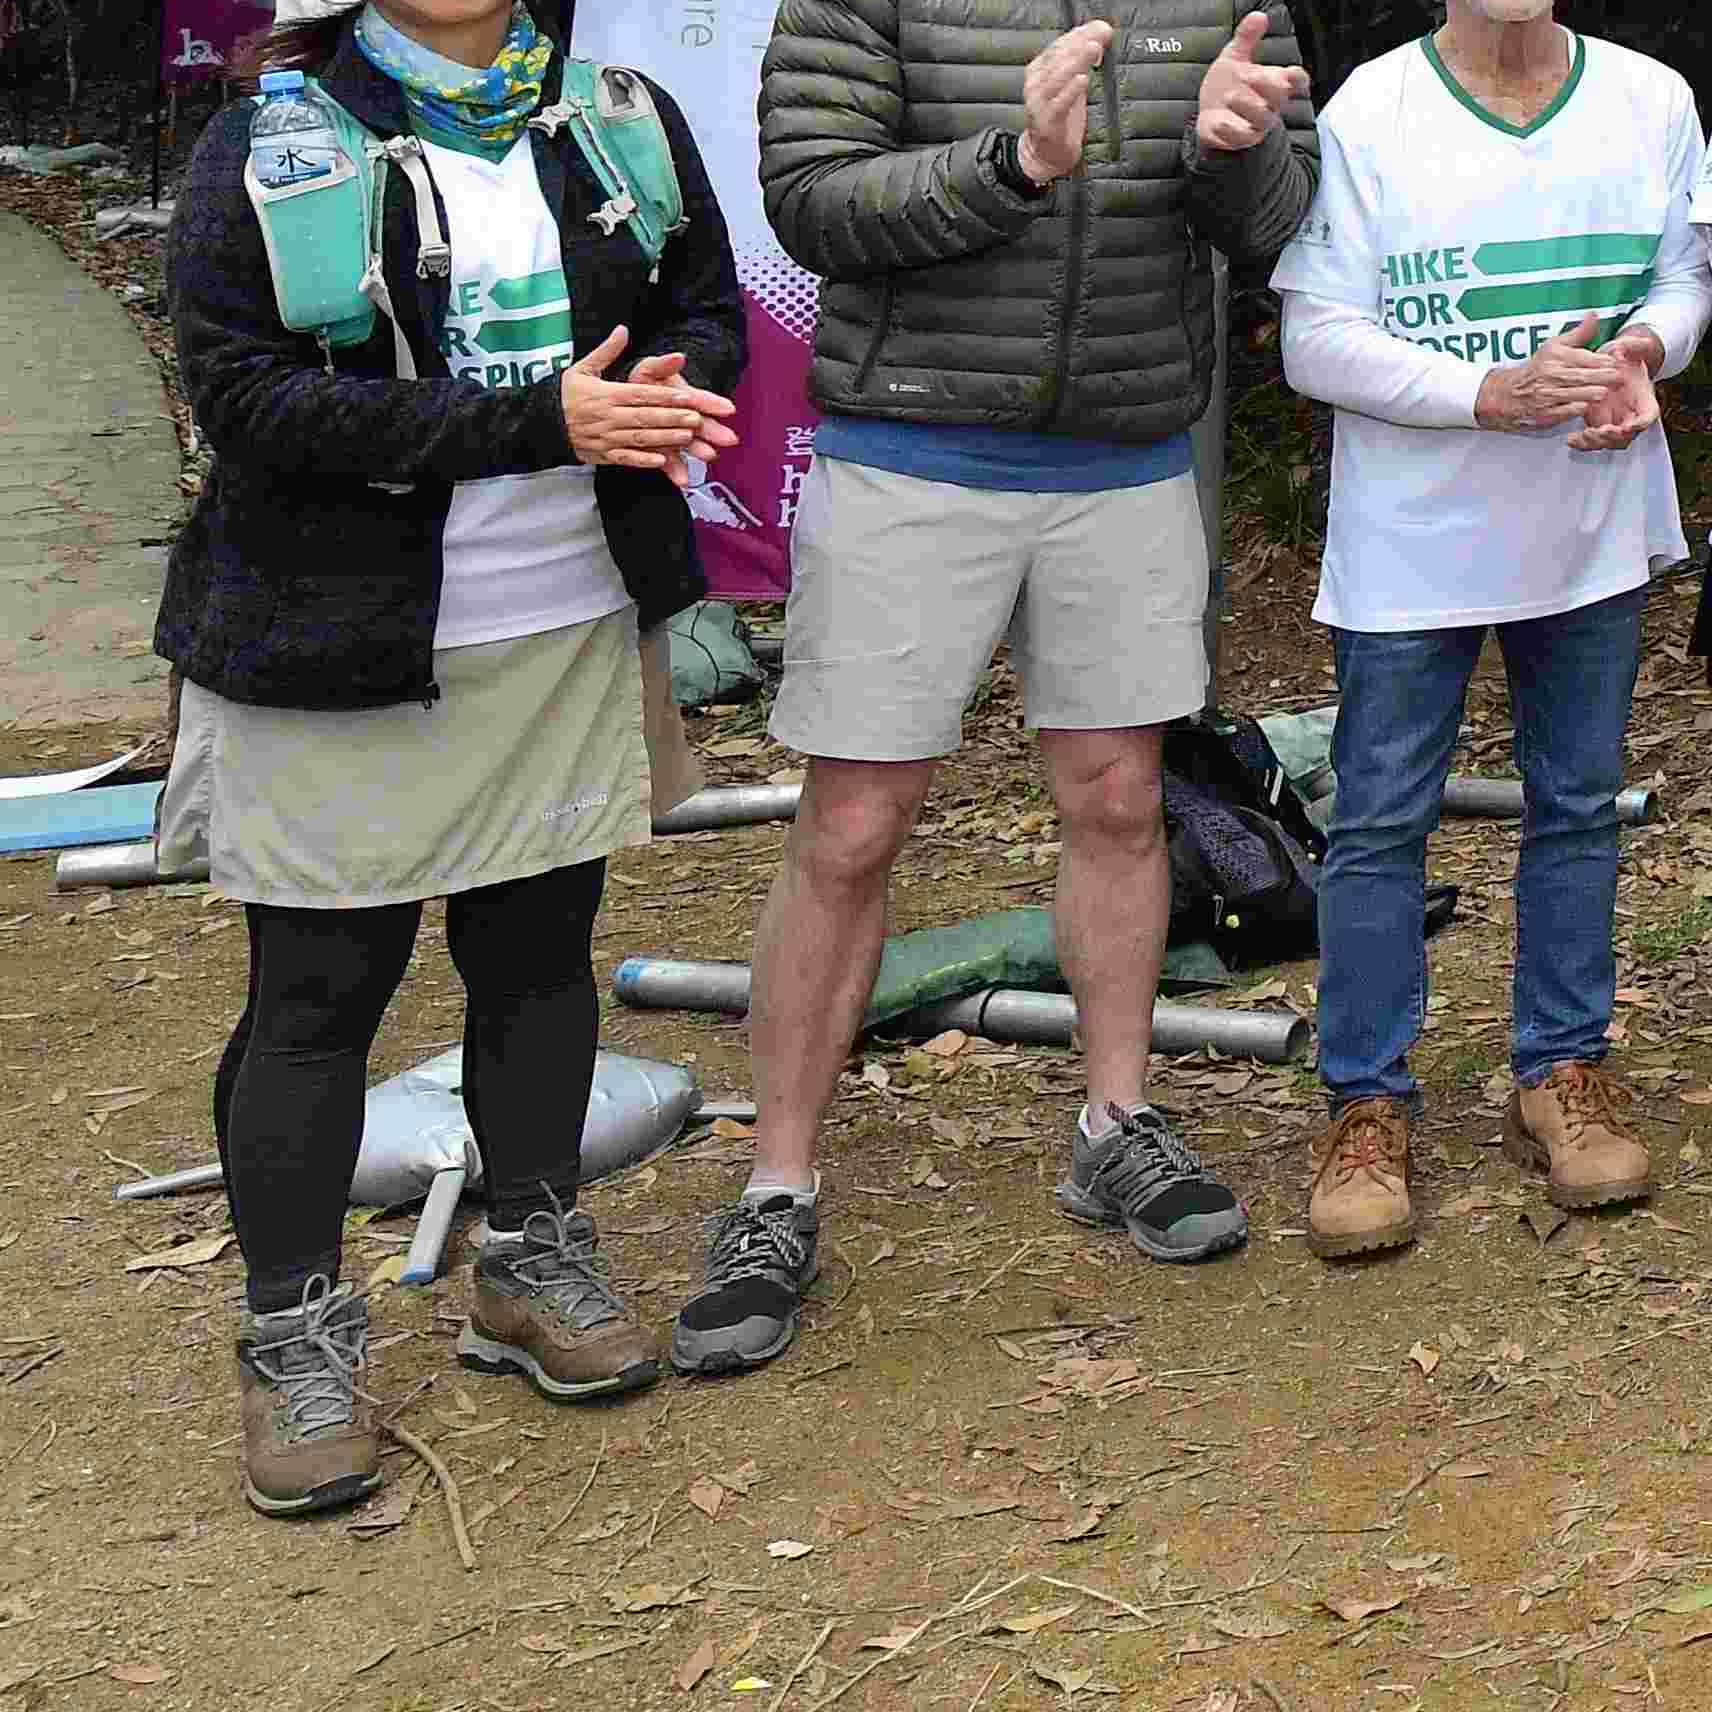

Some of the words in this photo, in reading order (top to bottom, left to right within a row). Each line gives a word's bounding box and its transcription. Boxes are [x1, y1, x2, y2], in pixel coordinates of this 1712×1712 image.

[1147, 34, 1183, 54] Rab
[276, 148, 317, 173] 水
[1381, 245, 1469, 288] HIKE
[1382, 293, 1456, 330] FOR
